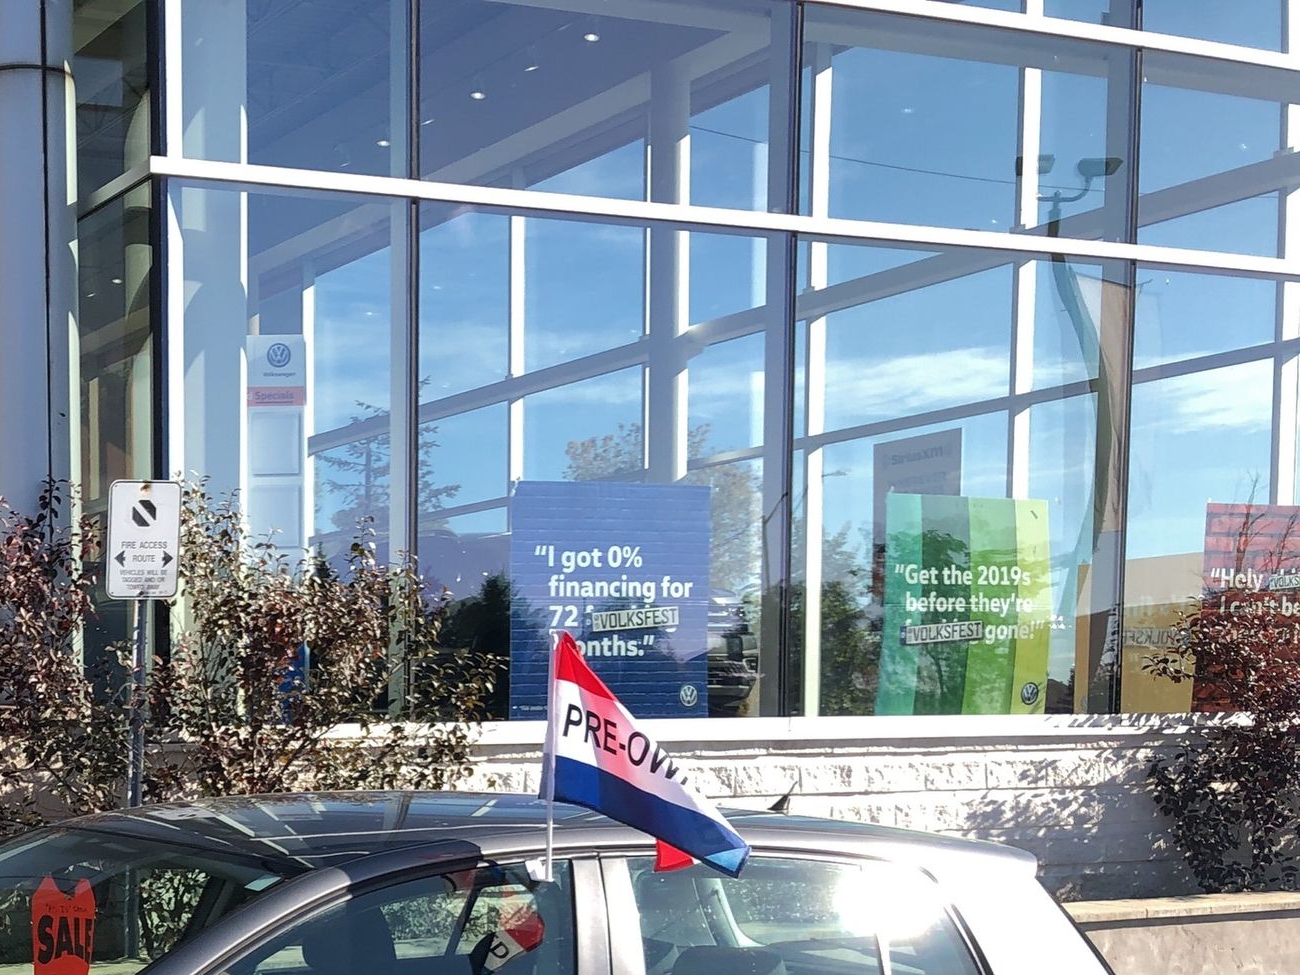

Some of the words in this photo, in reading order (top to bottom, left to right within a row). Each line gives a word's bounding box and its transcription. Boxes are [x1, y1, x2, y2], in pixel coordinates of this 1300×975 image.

[254, 390, 294, 402] Specials
[121, 541, 137, 550] FIRE
[139, 541, 168, 550] ACCESS
[132, 554, 156, 562] ROUTE
[561, 548, 602, 573] got
[607, 545, 643, 568] 0%
[942, 564, 973, 585] the
[977, 565, 1032, 586] 2019s
[548, 574, 656, 604] financing
[661, 575, 693, 598] for
[905, 591, 966, 612] before
[970, 592, 1033, 617] they're
[549, 605, 579, 627] 72
[599, 608, 678, 629] VOLKSFEST
[912, 622, 982, 641] VOLKSFEST
[574, 634, 654, 656] onths.”
[562, 703, 688, 786] PRE-OW
[38, 914, 93, 965] SALE
